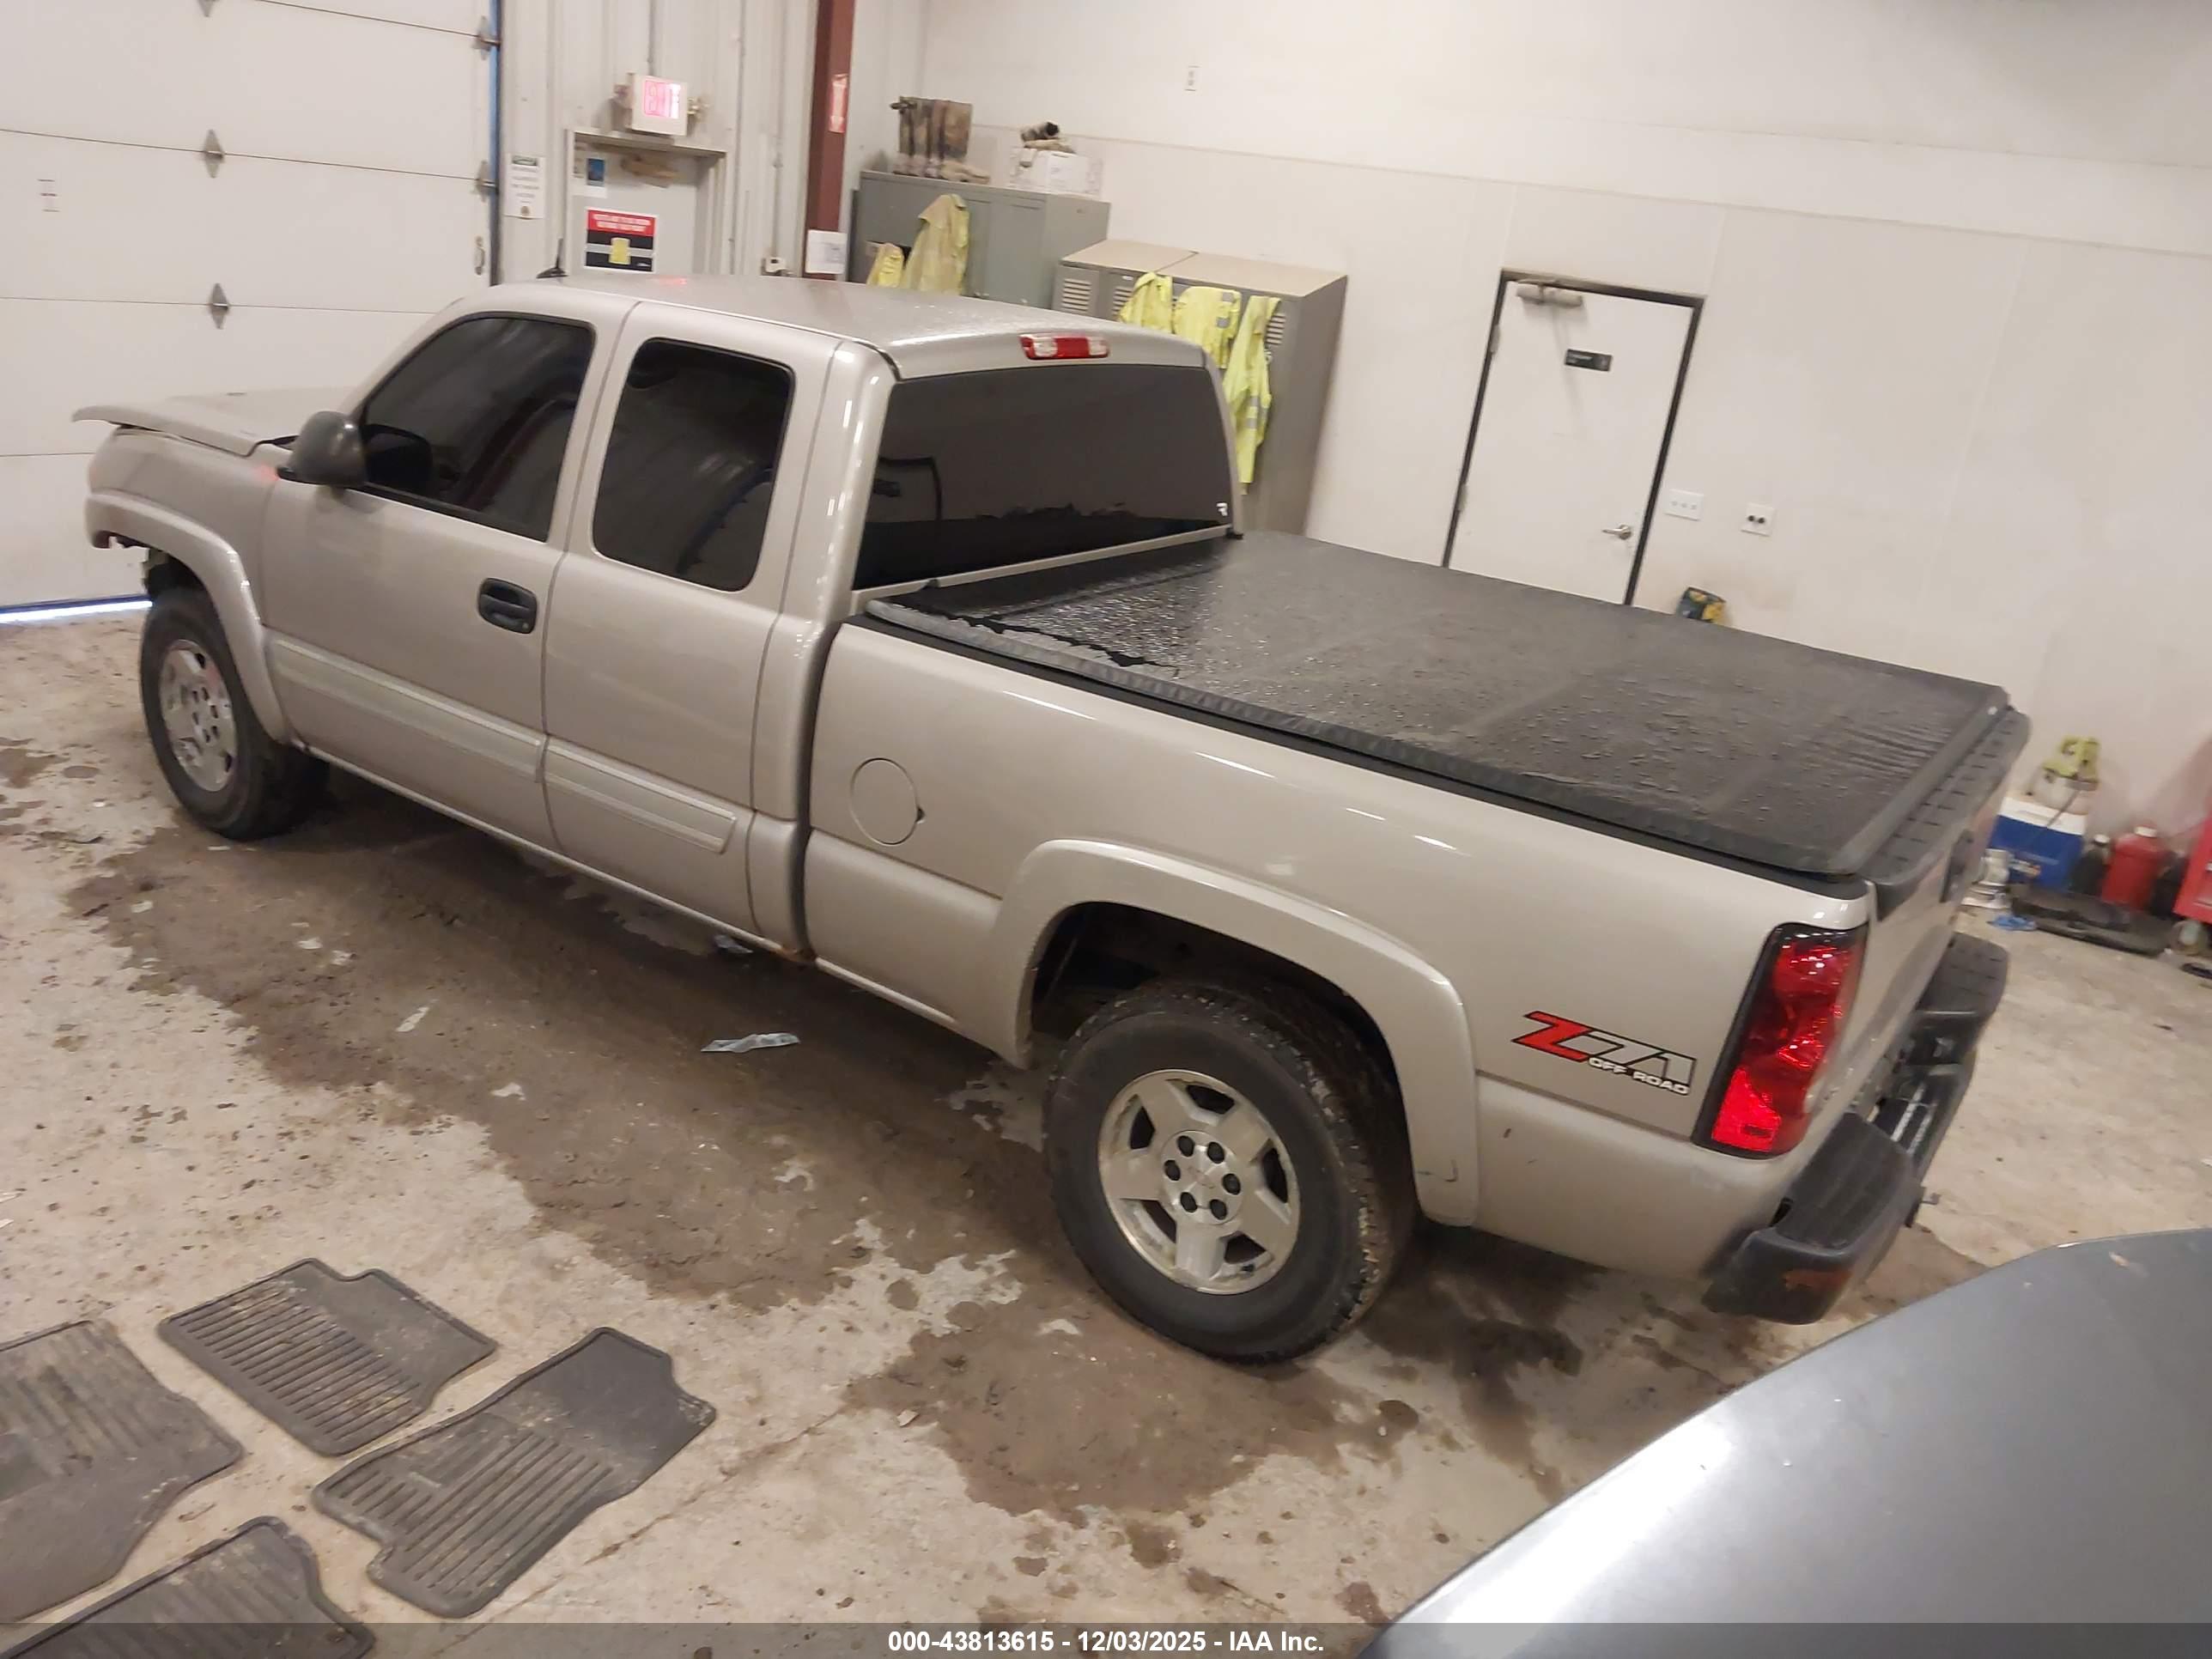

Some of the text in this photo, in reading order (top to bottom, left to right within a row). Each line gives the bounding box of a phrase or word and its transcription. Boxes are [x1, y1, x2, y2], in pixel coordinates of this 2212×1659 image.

[1510, 1010, 1697, 1086] Z71
[1588, 1056, 1691, 1096] OFF ROAD
